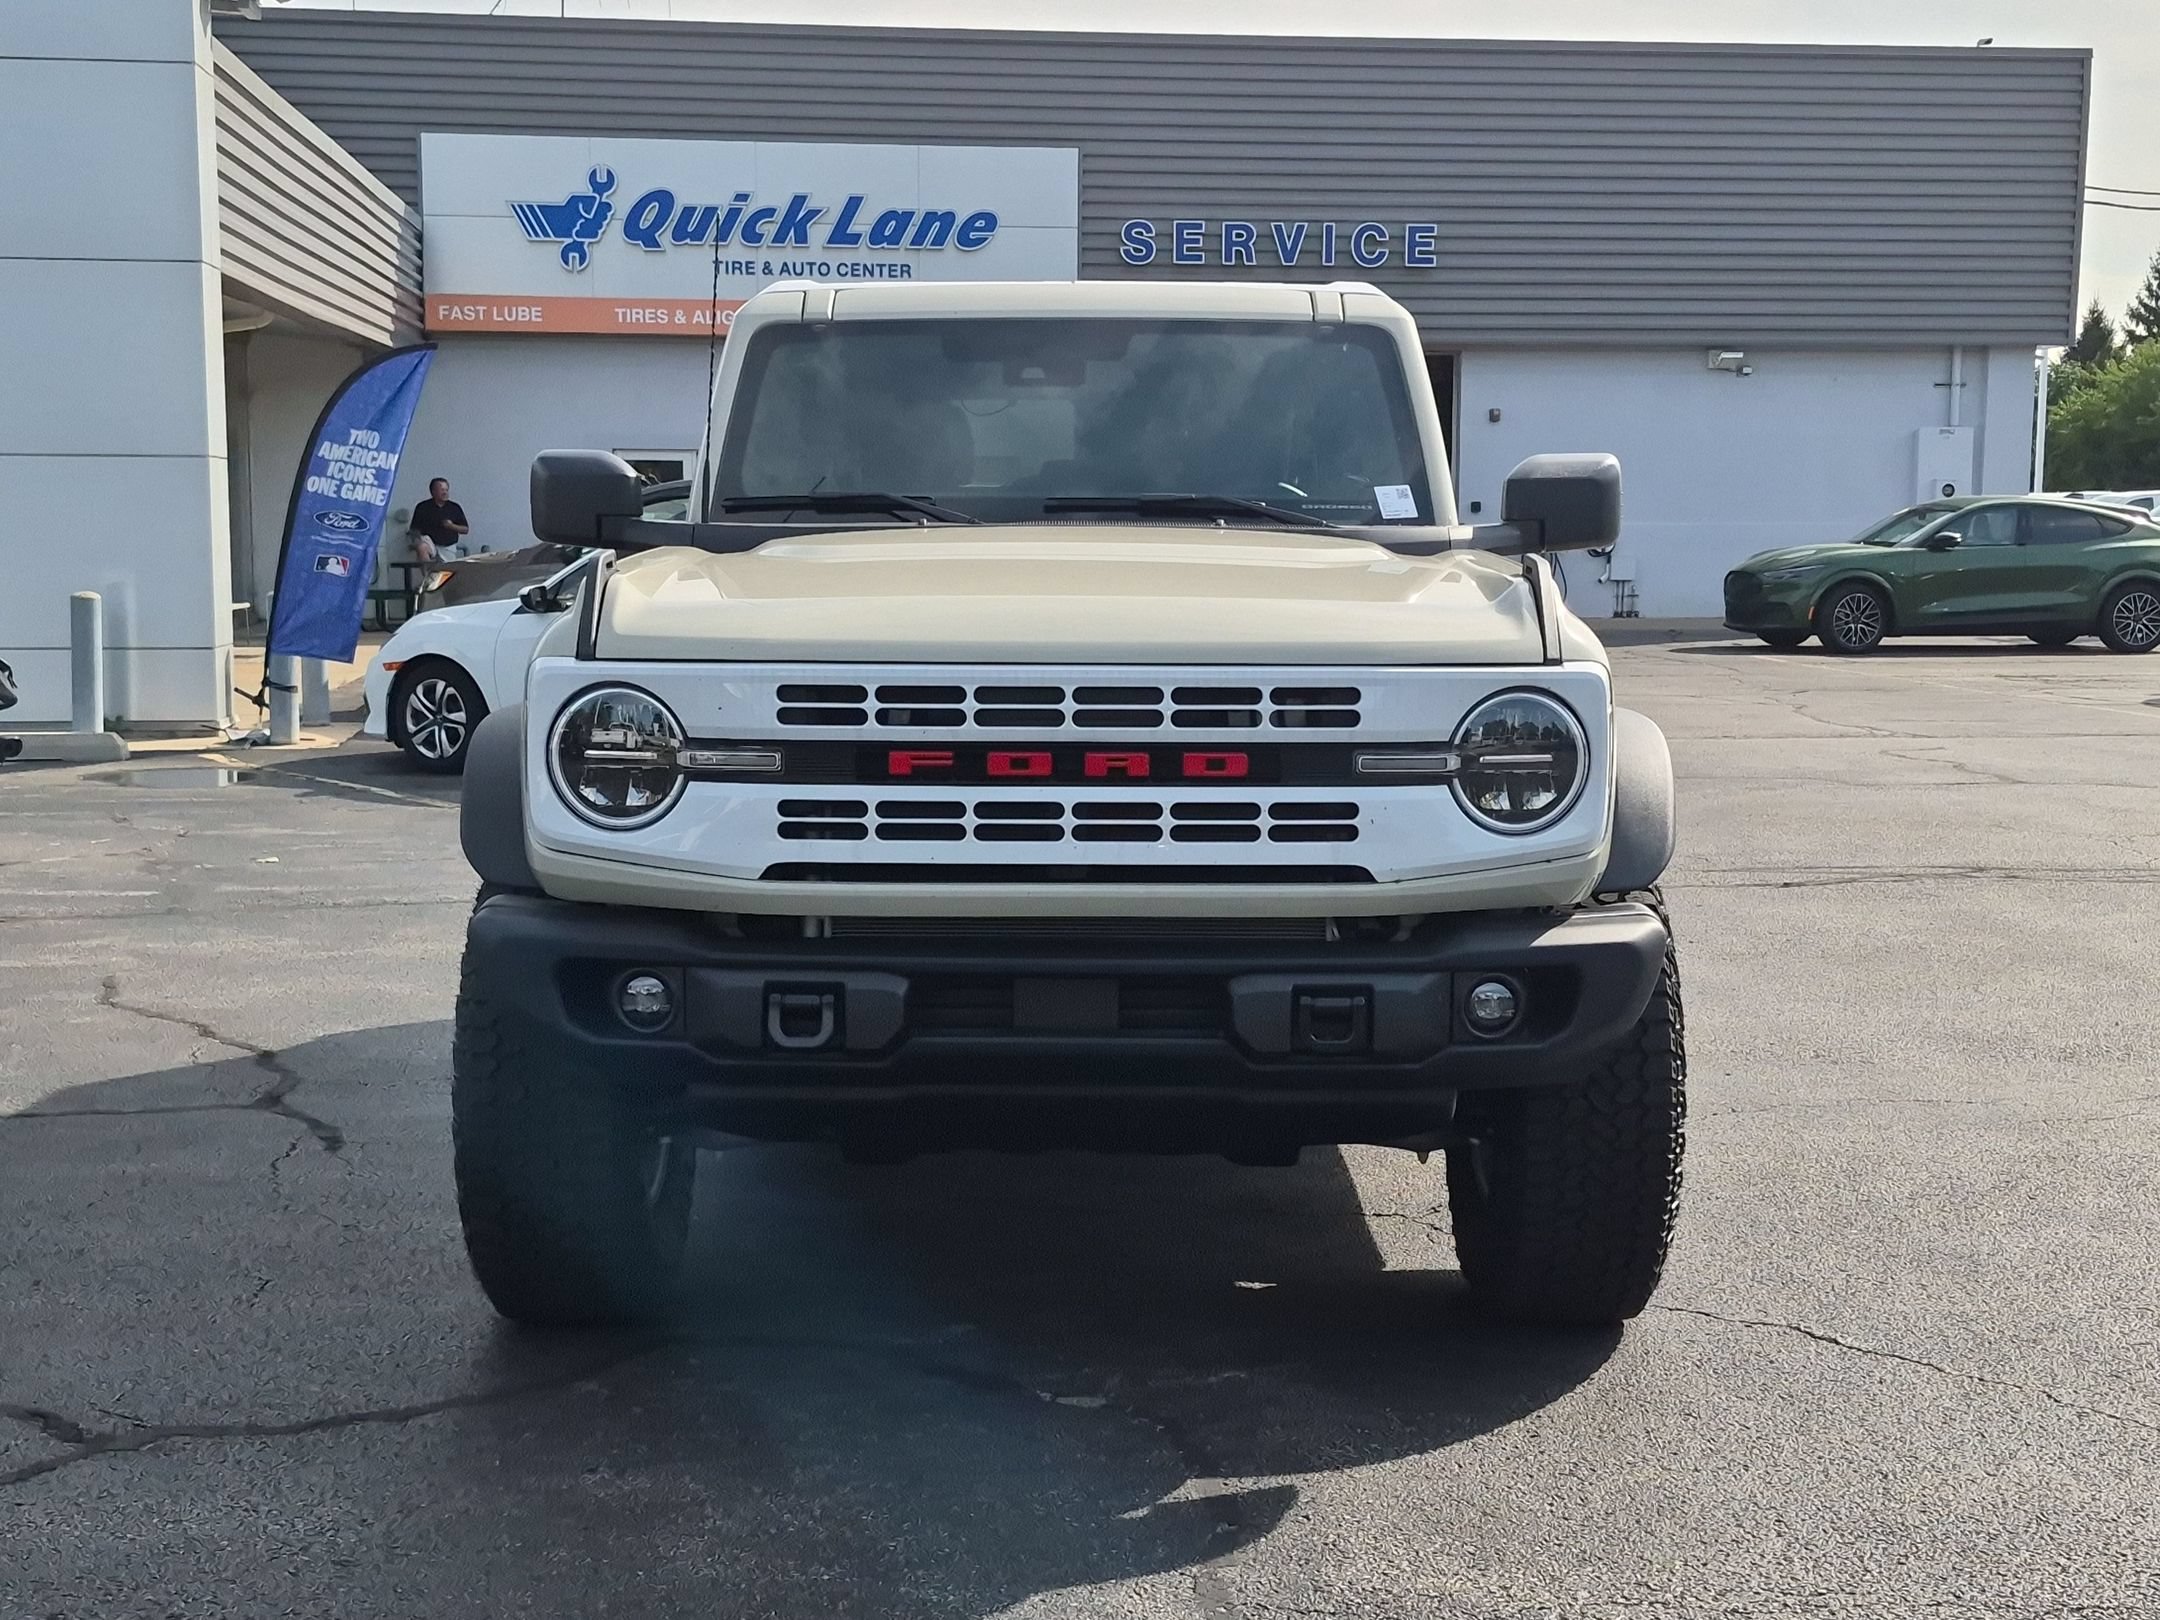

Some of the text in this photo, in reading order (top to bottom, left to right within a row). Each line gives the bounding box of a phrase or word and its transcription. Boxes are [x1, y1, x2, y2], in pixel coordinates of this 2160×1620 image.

[622, 187, 1000, 252] Quick Lane
[1119, 219, 1438, 267] SERVICE
[712, 260, 912, 279] TIRE & AUTO CENTER
[438, 305, 543, 322] FAST LUBE
[615, 308, 669, 324] TIRES
[674, 309, 687, 324] &
[348, 428, 380, 449] TWO
[317, 441, 399, 471] AMERICAN
[327, 461, 379, 485] ICONS.
[306, 476, 340, 498] ONE
[324, 512, 360, 529] Ford
[888, 751, 1249, 777] FORD
